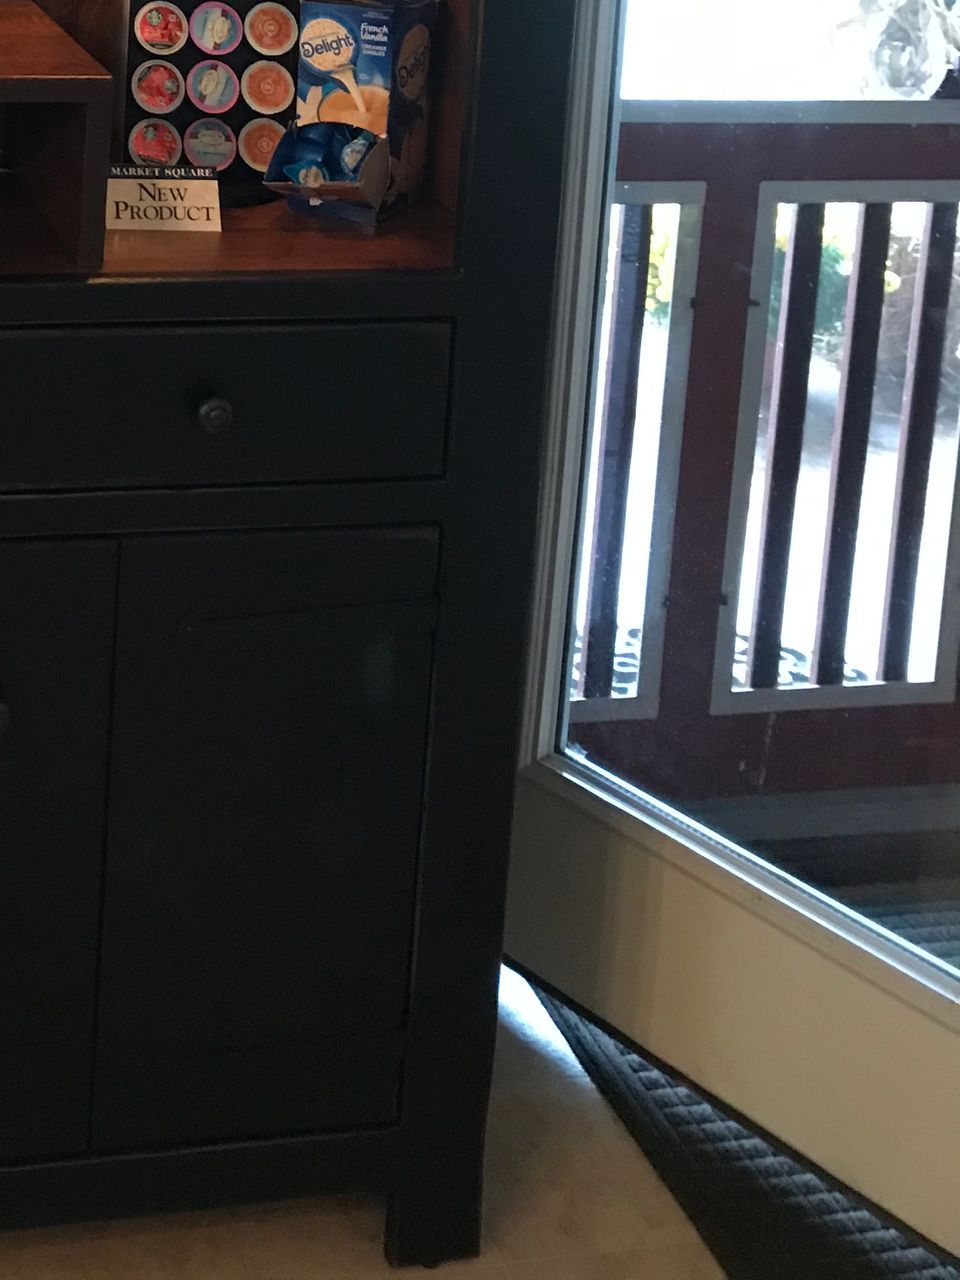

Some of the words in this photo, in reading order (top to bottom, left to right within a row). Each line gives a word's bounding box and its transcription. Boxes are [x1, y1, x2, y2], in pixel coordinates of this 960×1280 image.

[360, 22, 388, 34] French
[360, 31, 388, 42] Vanilla
[301, 33, 354, 58] Delight
[110, 166, 160, 177] MARKET
[164, 166, 213, 178] SQUARE
